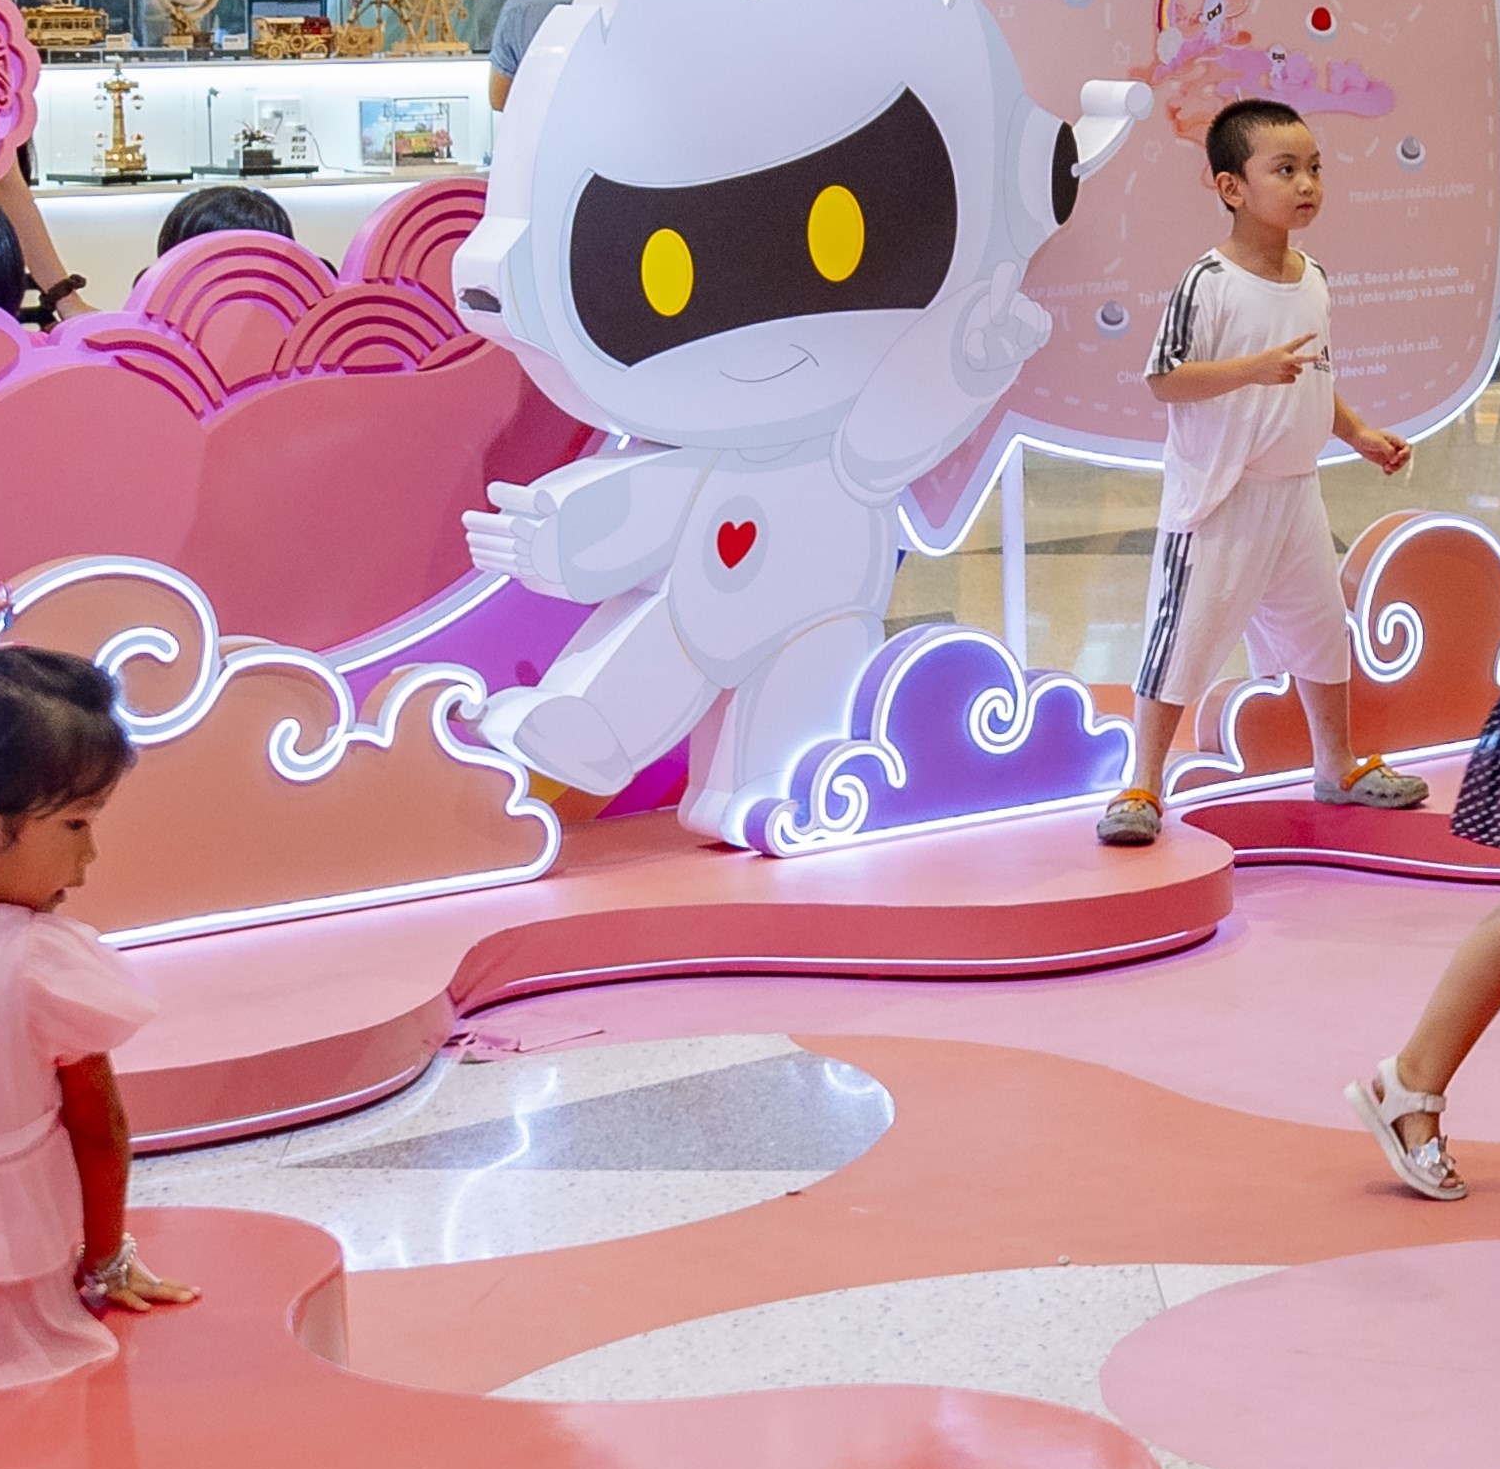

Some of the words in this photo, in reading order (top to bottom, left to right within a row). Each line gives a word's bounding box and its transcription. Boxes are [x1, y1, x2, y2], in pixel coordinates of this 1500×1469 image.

[1327, 270, 1362, 288] RĂNG,
[1364, 271, 1391, 285] Beso
[1406, 268, 1426, 281] đúc
[1427, 265, 1459, 278] khuôn
[1138, 291, 1155, 307] Tại
[1358, 289, 1385, 305] (màu
[1388, 287, 1418, 302] vàng)
[1420, 285, 1433, 297] và
[1434, 284, 1456, 295] sum
[1340, 365, 1365, 378] theo
